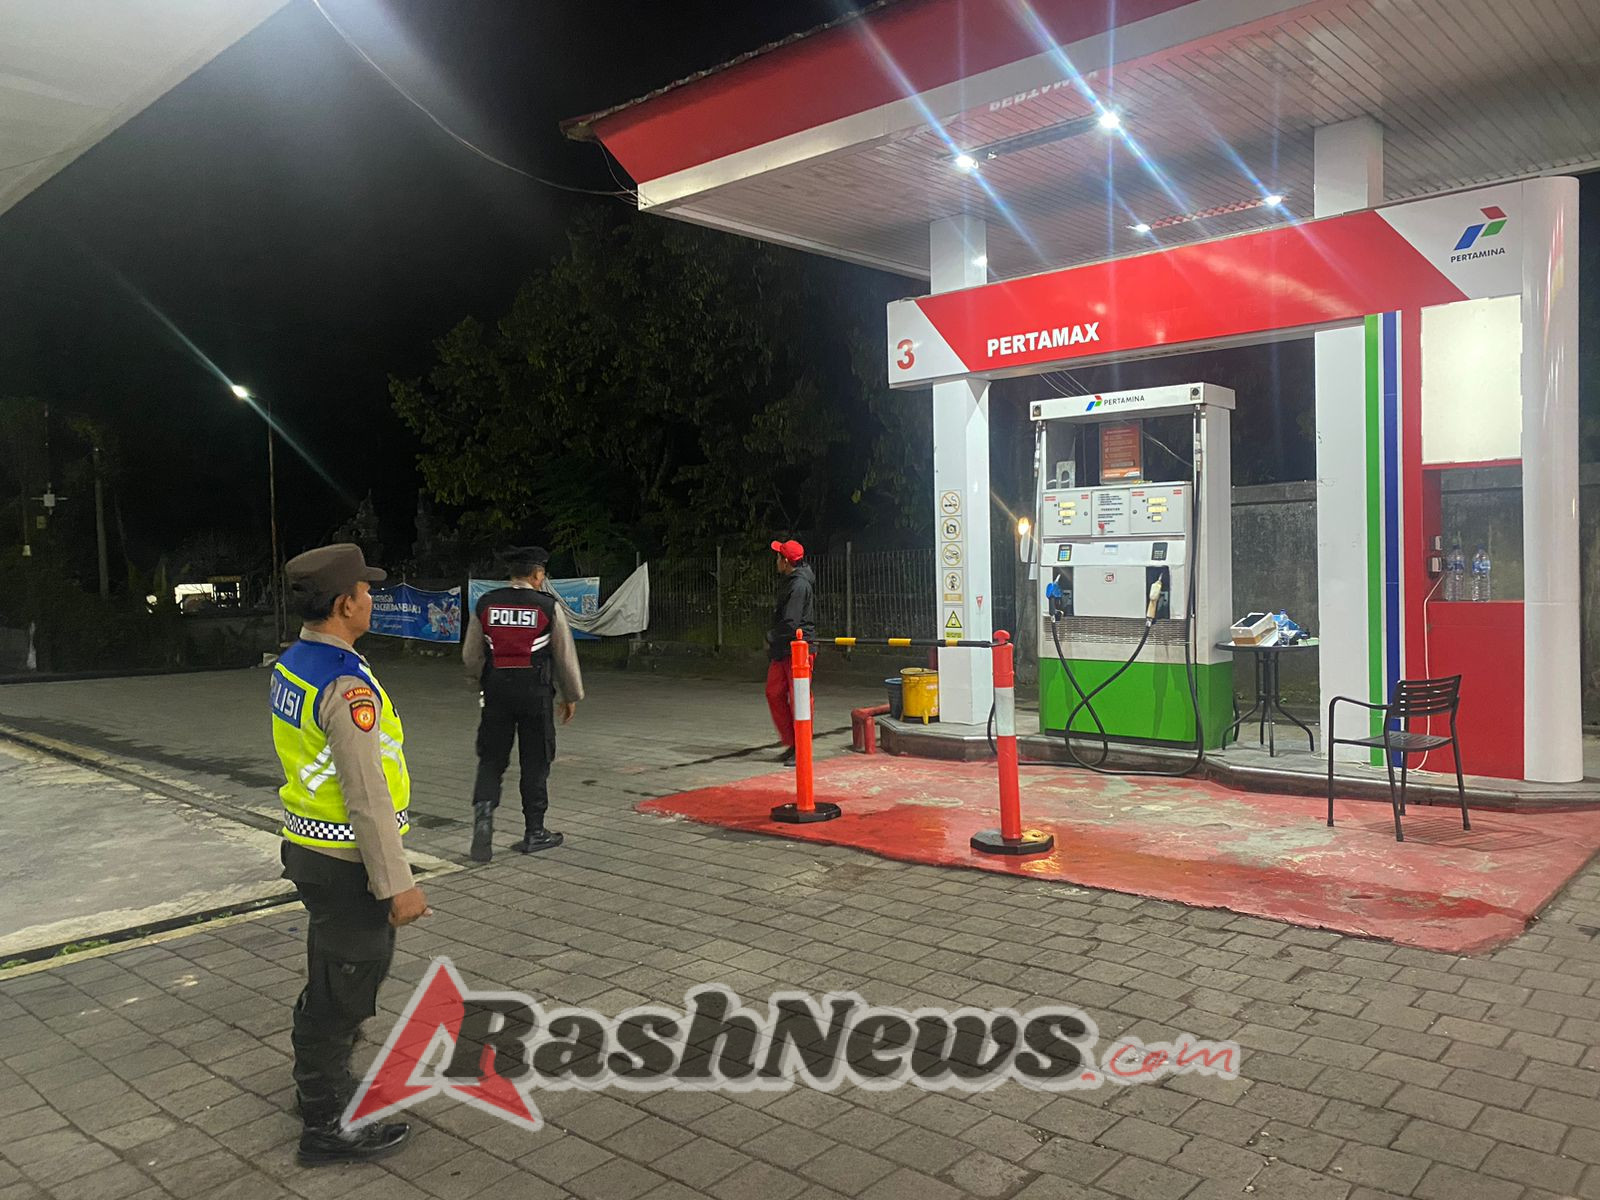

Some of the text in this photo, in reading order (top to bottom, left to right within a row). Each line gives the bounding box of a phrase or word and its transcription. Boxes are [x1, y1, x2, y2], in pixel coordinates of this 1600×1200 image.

[1450, 247, 1506, 263] PERTAMINA
[987, 322, 1100, 357] PERTAMAX
[897, 338, 915, 370] 3
[1103, 395, 1145, 406] PERTAMINA
[490, 609, 536, 626] POLISI
